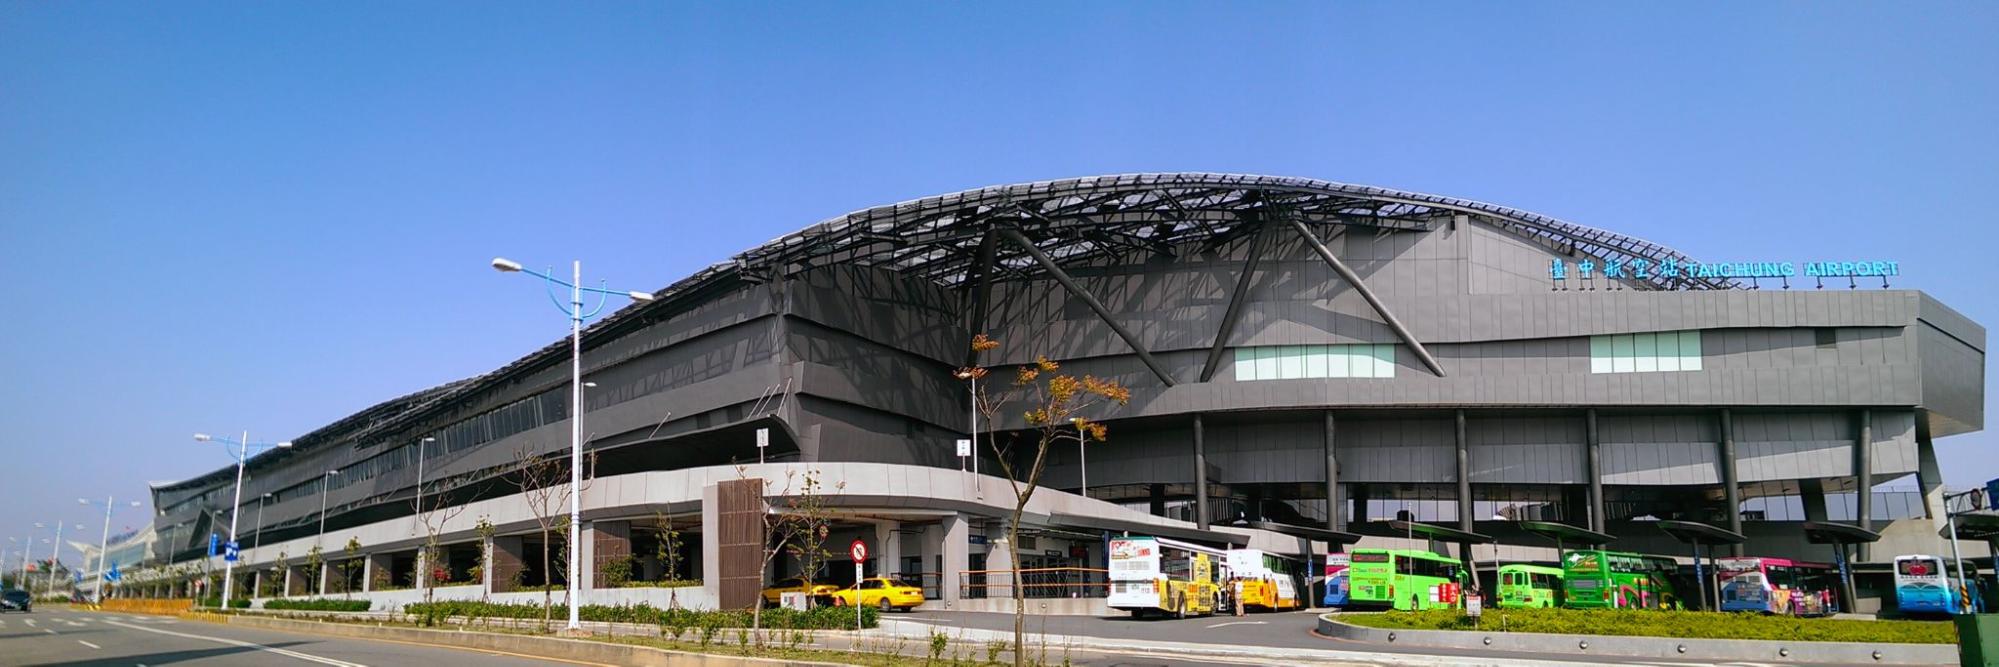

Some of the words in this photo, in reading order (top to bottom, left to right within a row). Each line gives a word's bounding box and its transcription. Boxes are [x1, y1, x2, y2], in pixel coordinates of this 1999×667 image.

[1550, 258, 1678, 279] 臺中航空站
[1686, 262, 1794, 277] TAICHUNG
[1805, 261, 1898, 276] AIRPORT
